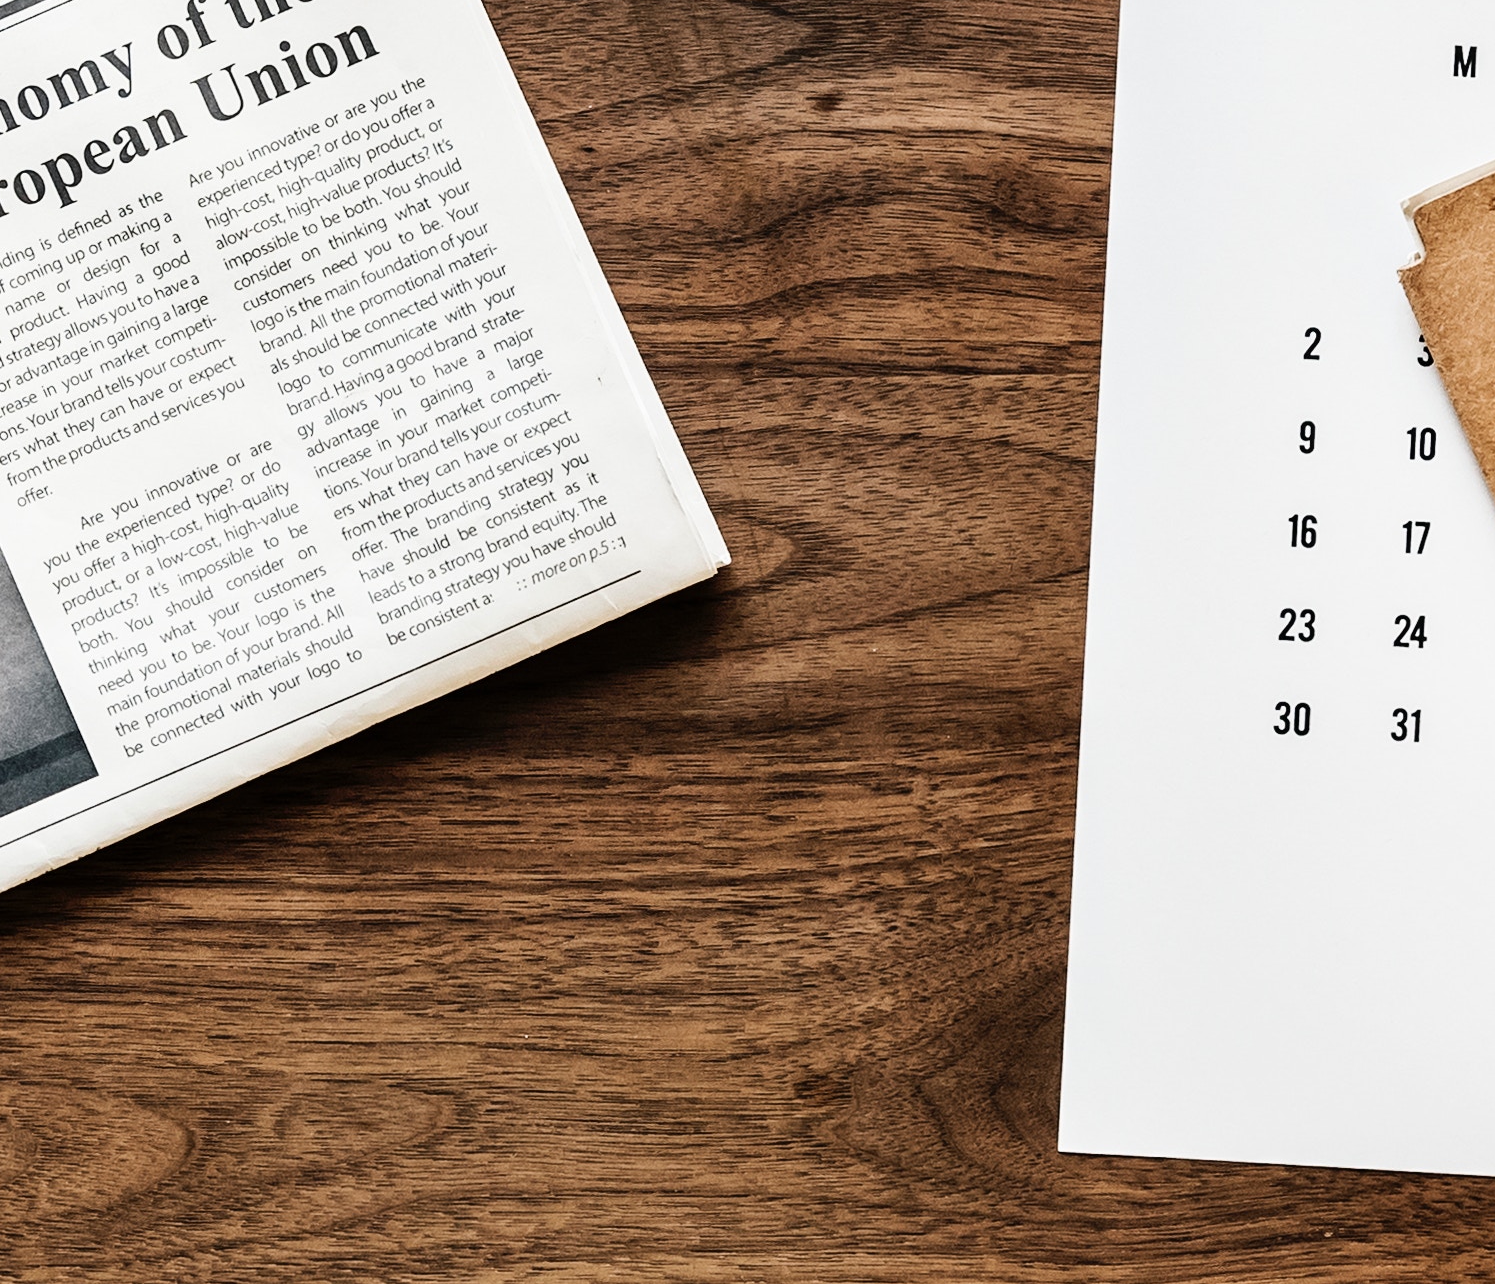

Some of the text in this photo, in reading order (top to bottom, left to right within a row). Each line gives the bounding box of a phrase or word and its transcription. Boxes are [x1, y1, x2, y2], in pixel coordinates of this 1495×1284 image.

[189, 24, 382, 123] Union
[1454, 46, 1477, 77] M
[38, 238, 52, 251] is
[57, 209, 112, 244] defined
[118, 204, 134, 218] as
[138, 191, 164, 209] the
[1304, 328, 1321, 360] 2
[1300, 421, 1436, 460] 9 10
[1289, 515, 1430, 554] 16 17
[1279, 609, 1315, 642] 23
[1394, 615, 1427, 648] 24
[1274, 702, 1421, 742] 30 31
